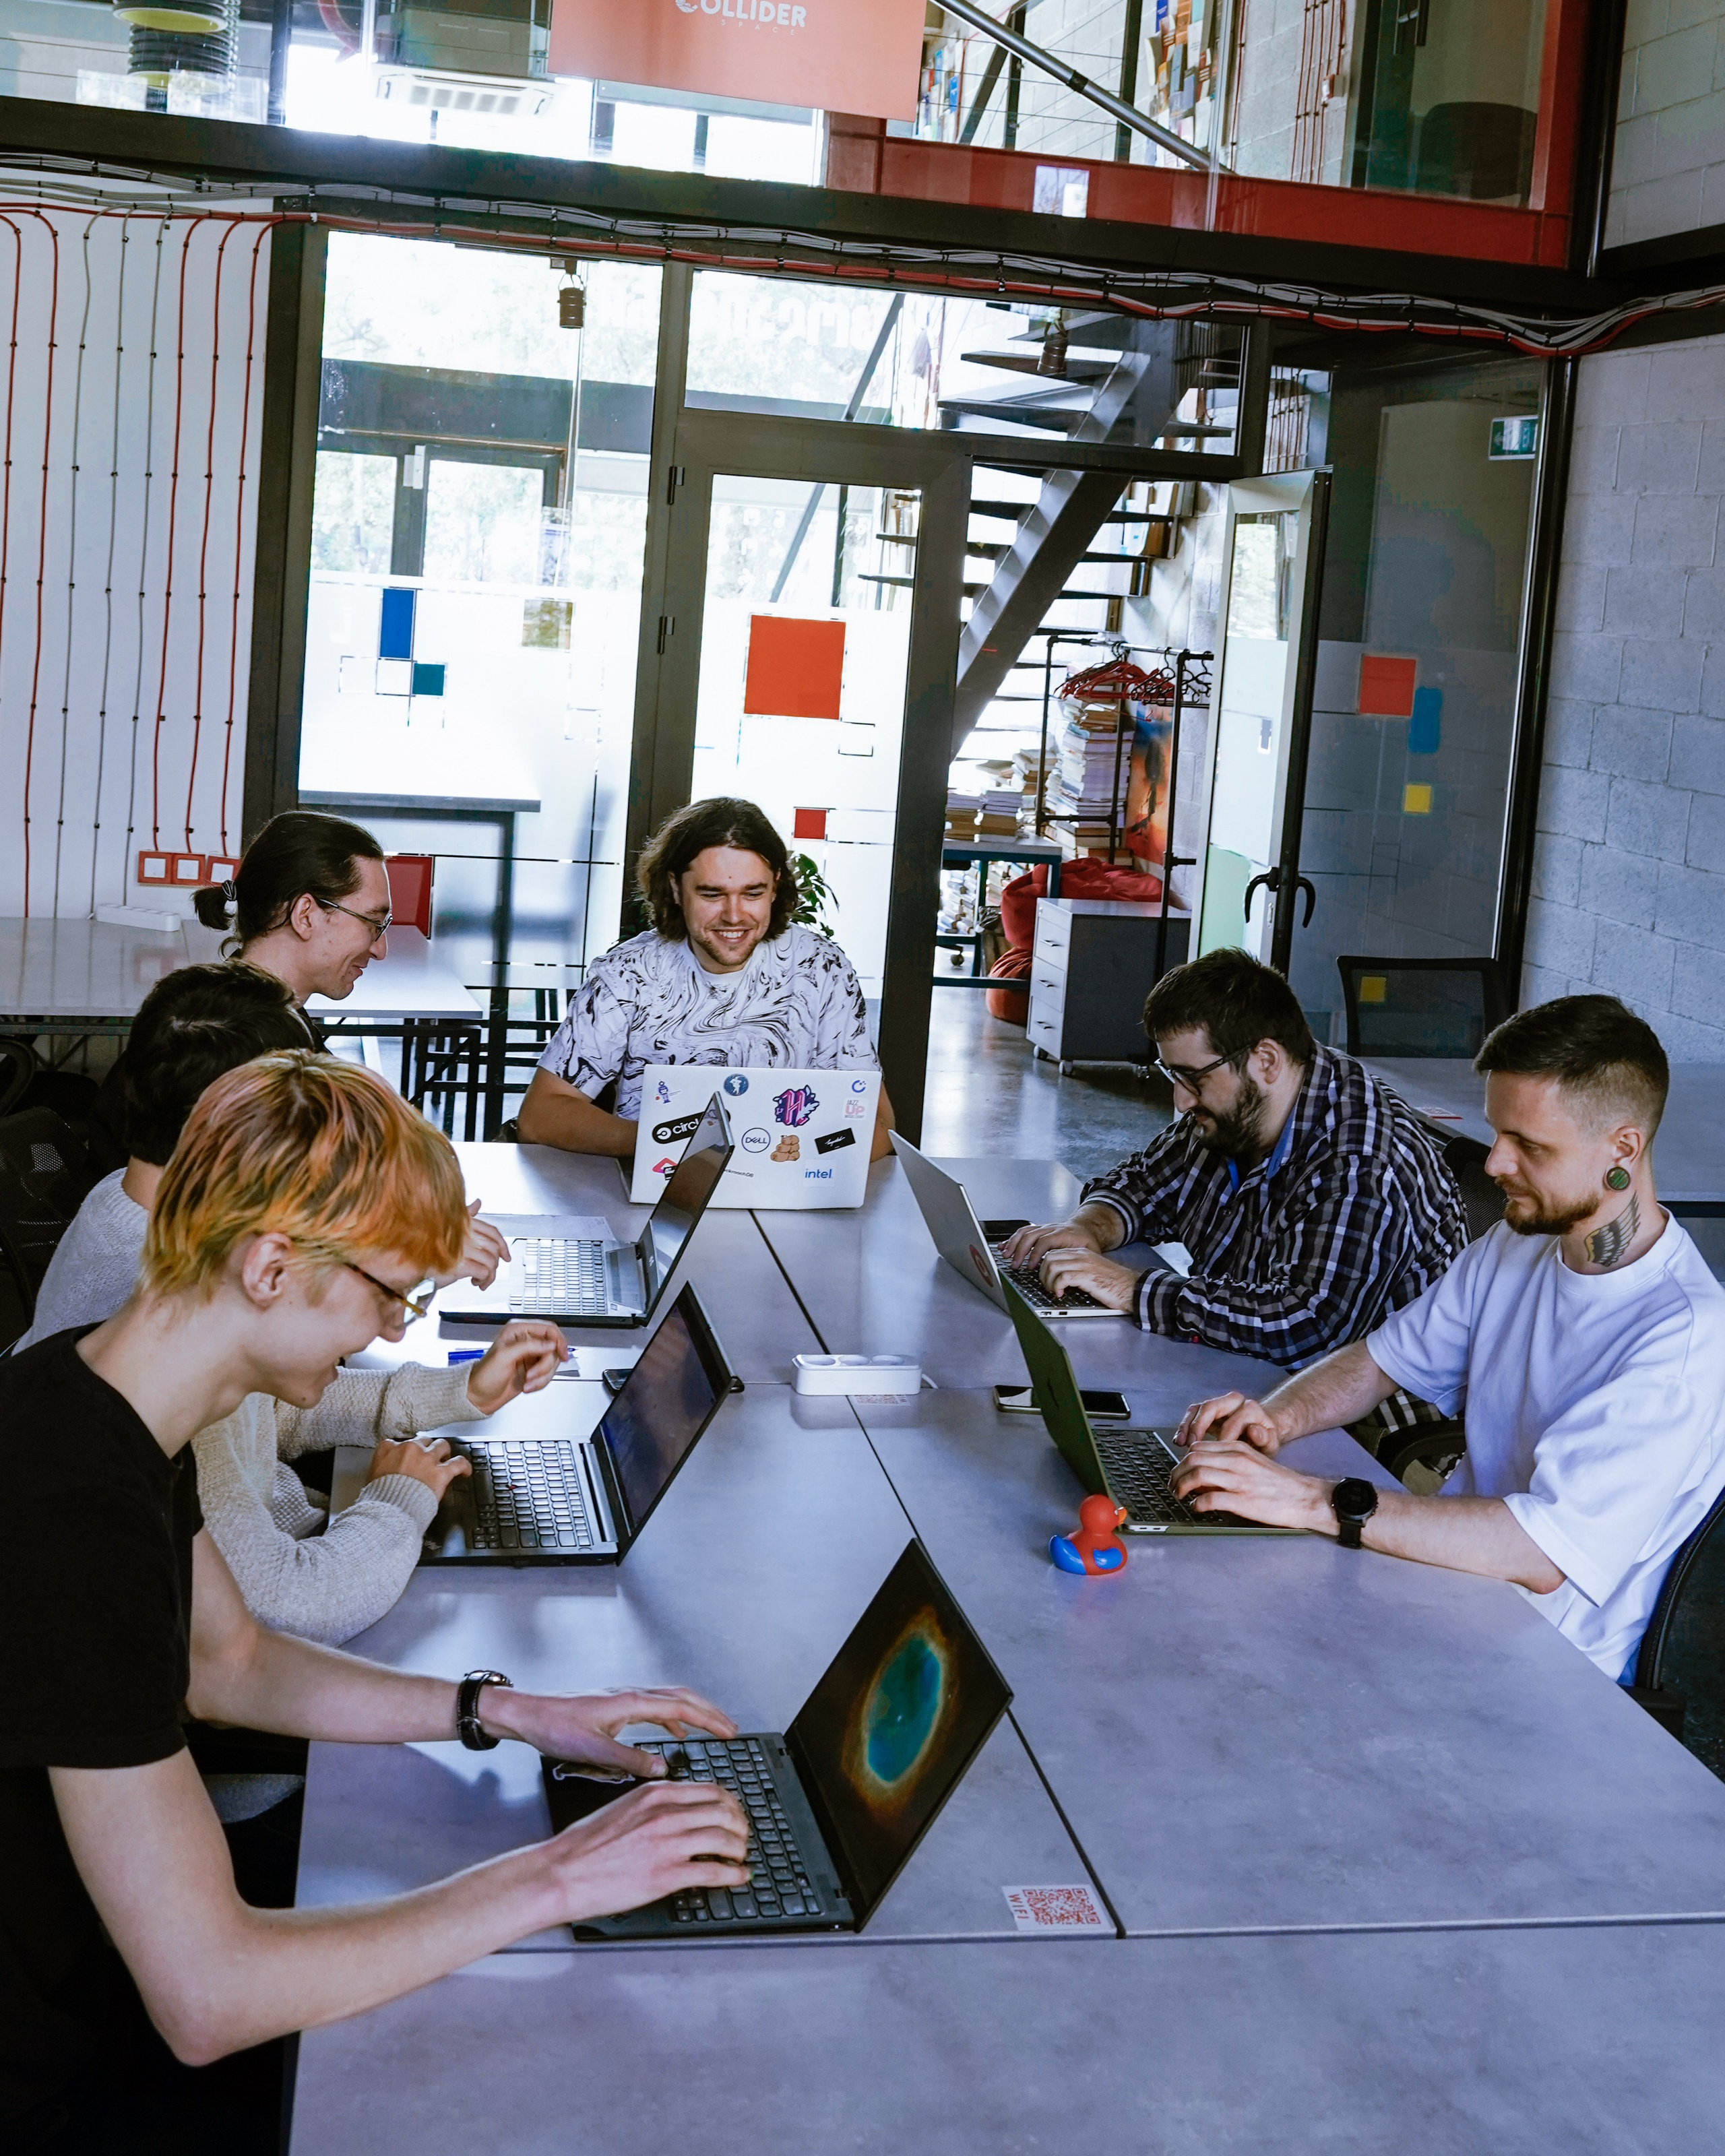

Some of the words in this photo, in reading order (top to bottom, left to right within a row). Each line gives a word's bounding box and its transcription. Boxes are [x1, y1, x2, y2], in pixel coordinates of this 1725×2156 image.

[721, 19, 795, 36] SPACE
[805, 1168, 832, 1178] intel
[1008, 1894, 1030, 1919] WIFI
